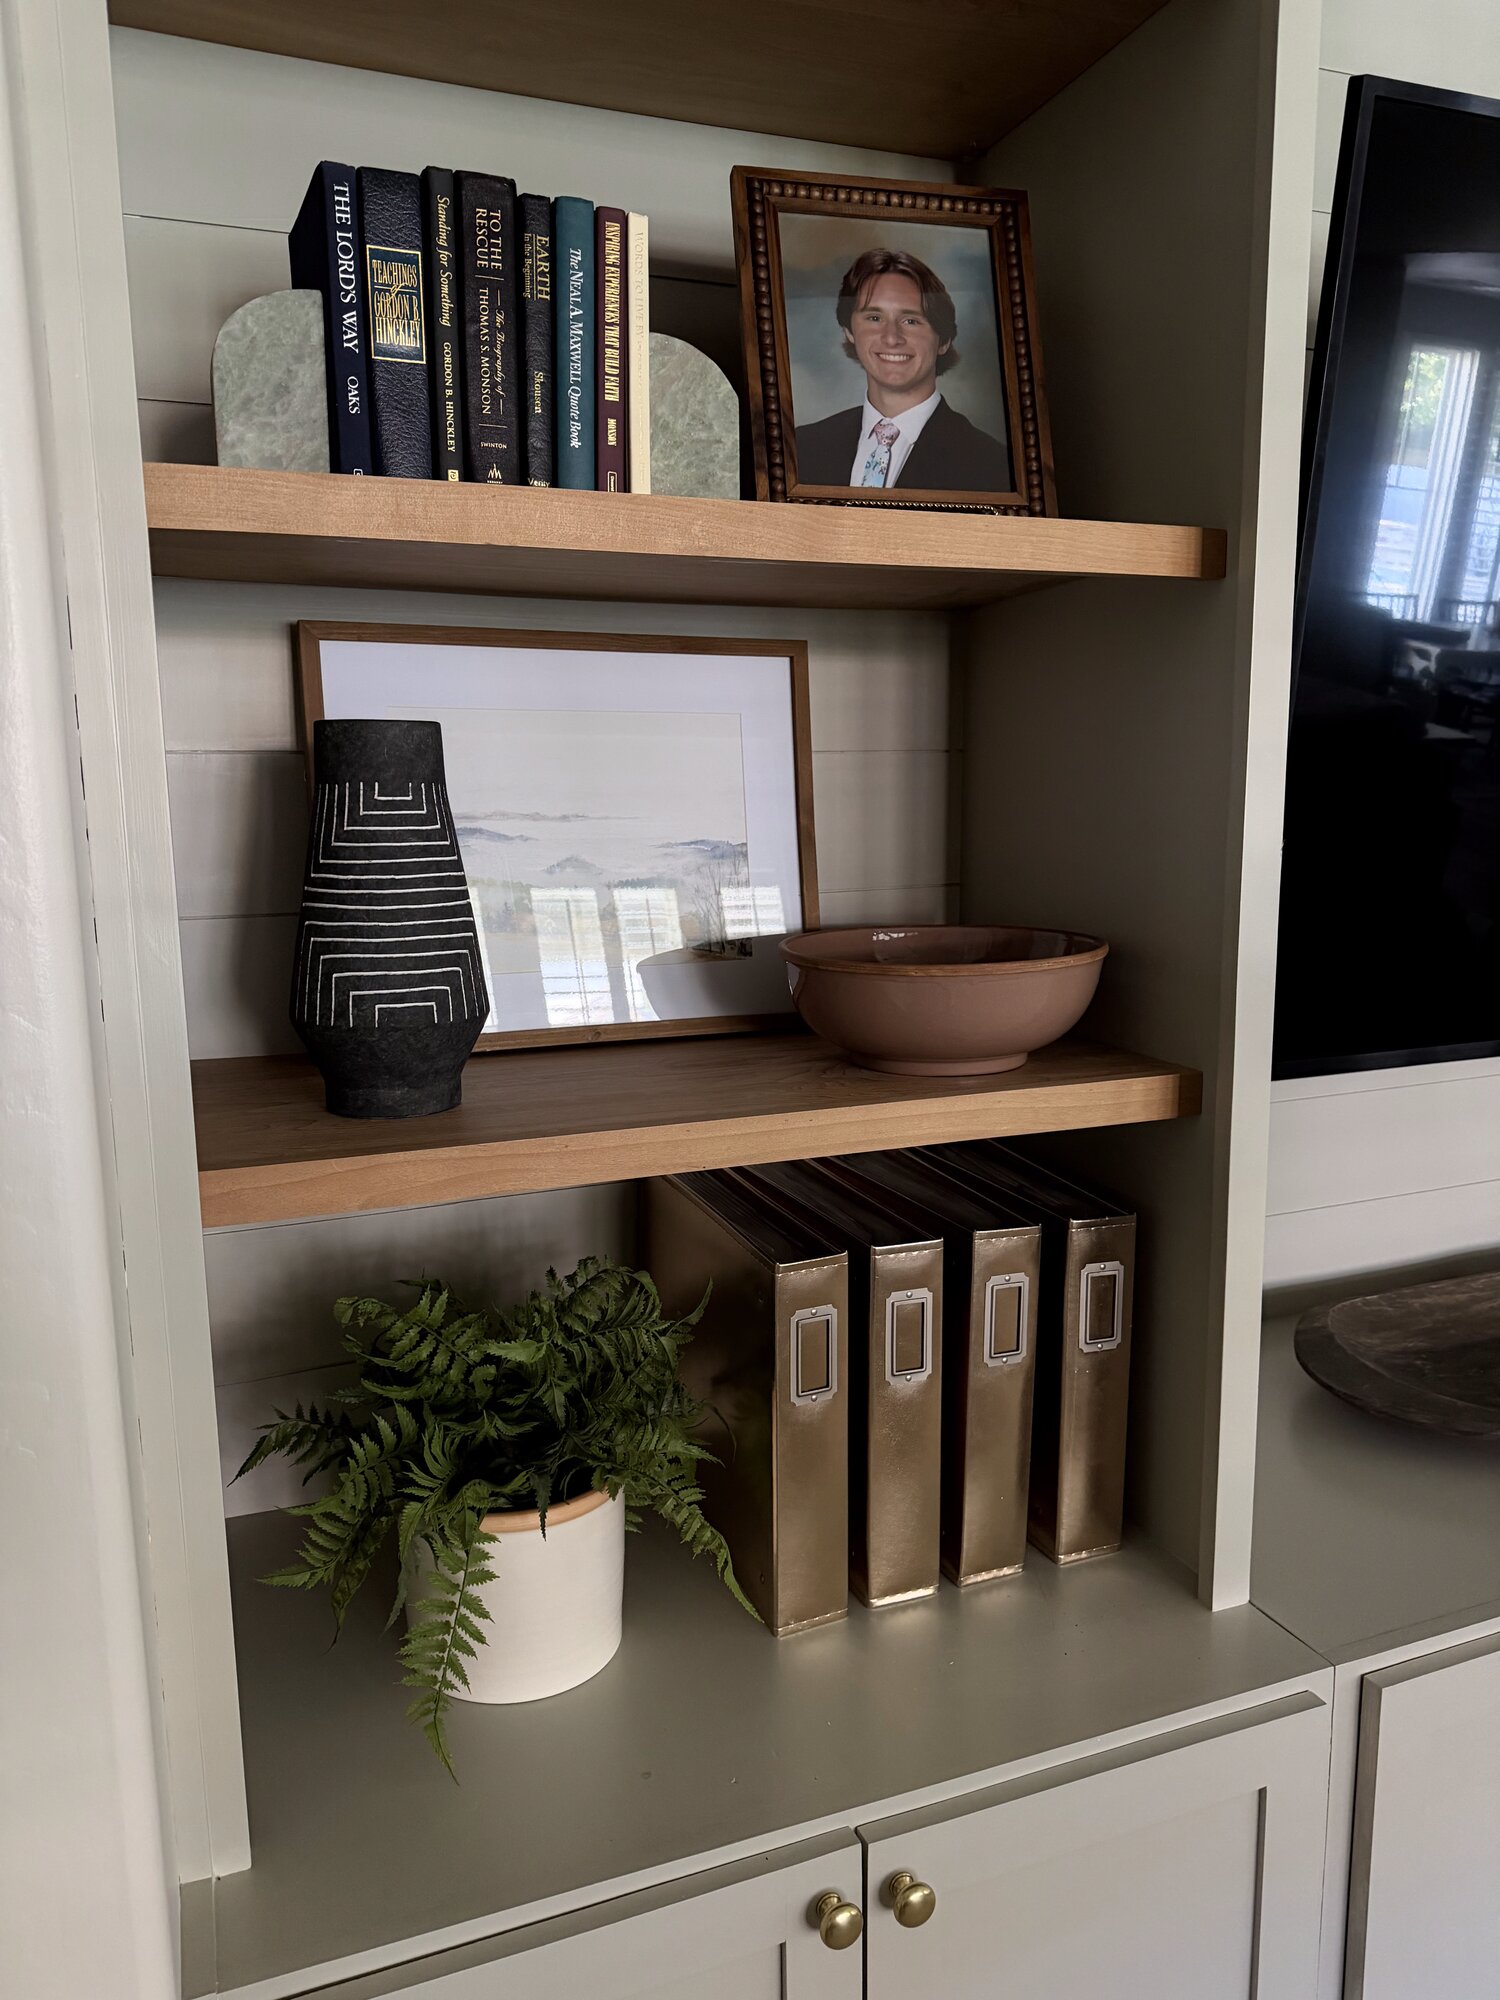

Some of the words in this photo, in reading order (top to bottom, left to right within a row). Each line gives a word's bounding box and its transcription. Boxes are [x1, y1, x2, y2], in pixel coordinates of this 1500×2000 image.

[333, 182, 351, 225] THE
[436, 194, 451, 247] Standing
[475, 208, 489, 268] RESCUE
[489, 209, 502, 233] TO
[524, 233, 532, 242] In
[437, 248, 453, 267] for
[490, 236, 502, 270] THE
[524, 243, 532, 256] the
[569, 248, 582, 269] The
[605, 221, 621, 265] INSPIRING
[634, 232, 644, 275] WORDS
[336, 231, 357, 304] LORD'S
[372, 259, 418, 288] TEACHINGS
[522, 258, 532, 298] Beginning
[536, 234, 550, 301] EARTH
[438, 269, 455, 327] Something
[569, 270, 584, 304] NEAL
[604, 266, 621, 323] EXPERIENCES
[374, 291, 411, 319] GORDON
[479, 287, 489, 341] THOMAS
[495, 309, 505, 328] The
[342, 310, 359, 354] WAY
[375, 317, 421, 347] HINCKLEY
[604, 325, 620, 347] THAT
[443, 342, 453, 387] GORDON
[480, 345, 490, 354] S.
[493, 330, 505, 384] Biography
[569, 321, 584, 384] MAXWELL
[604, 348, 620, 374] BUILD
[346, 375, 361, 414] OAKS
[444, 389, 453, 398] B.
[480, 356, 491, 415] MONSON
[495, 385, 506, 397] of
[533, 371, 544, 414] Skousen
[604, 375, 620, 402] FAITH
[567, 386, 582, 420] Quote
[445, 401, 456, 452] HINCKLEY
[569, 420, 582, 449] Book
[607, 418, 617, 446] MONSON
[480, 441, 507, 449] SWINTON
